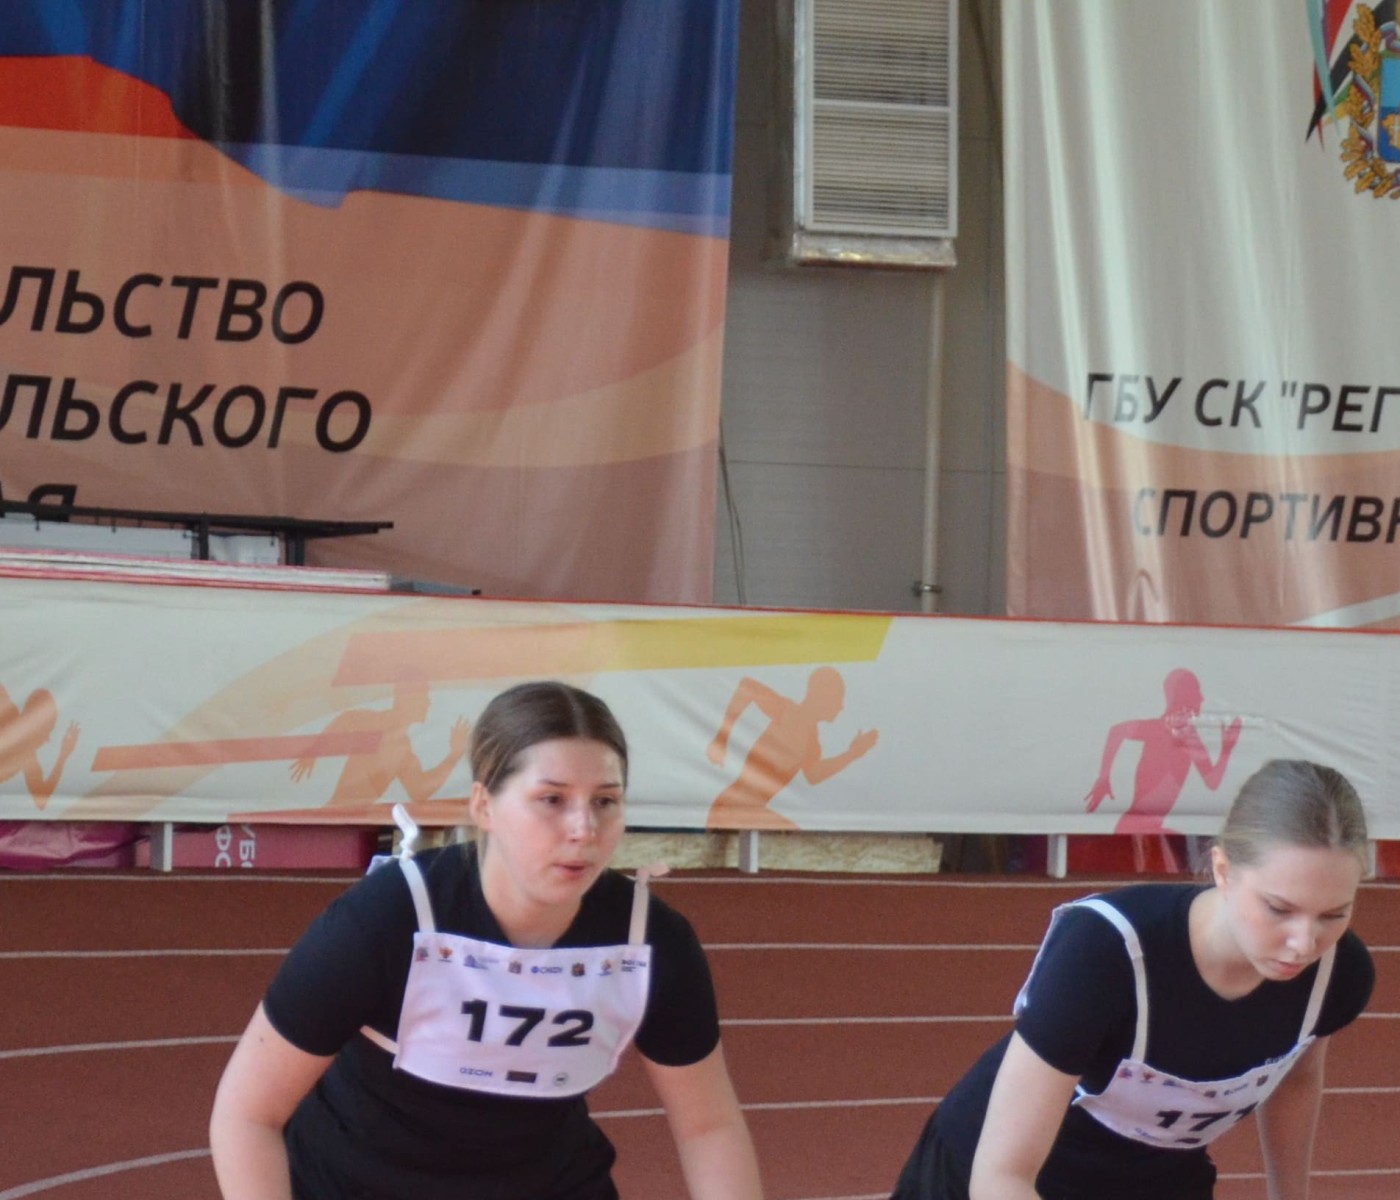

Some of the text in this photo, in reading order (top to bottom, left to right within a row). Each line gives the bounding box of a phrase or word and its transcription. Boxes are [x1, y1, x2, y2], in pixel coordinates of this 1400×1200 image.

[1084, 373, 1182, 424] ГБУ
[1194, 378, 1264, 429] СК
[461, 999, 594, 1047] 172
